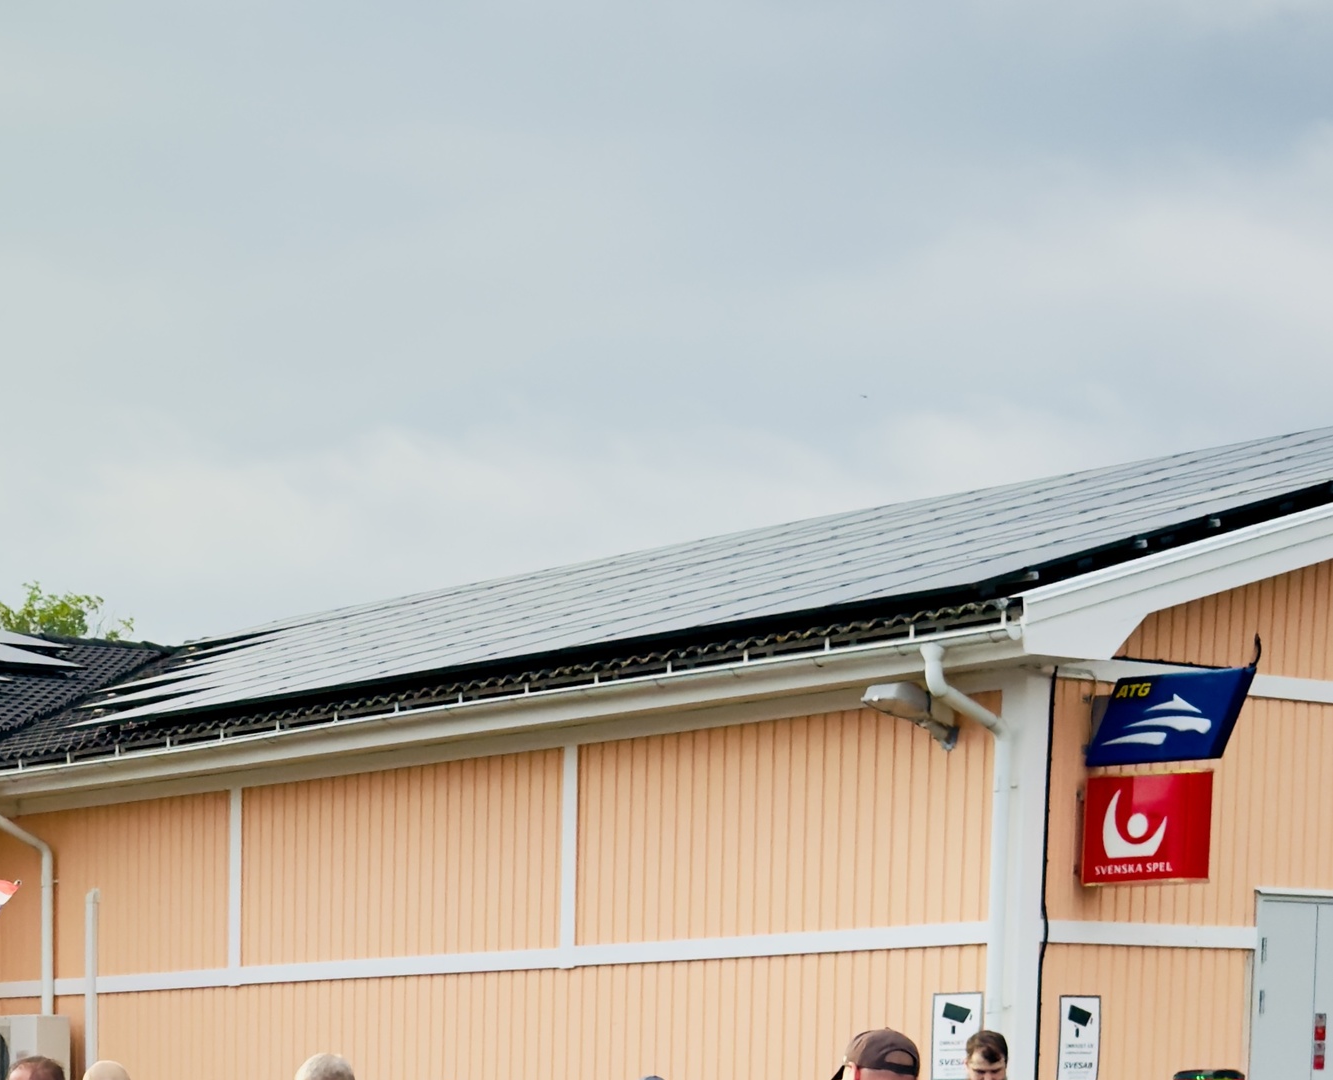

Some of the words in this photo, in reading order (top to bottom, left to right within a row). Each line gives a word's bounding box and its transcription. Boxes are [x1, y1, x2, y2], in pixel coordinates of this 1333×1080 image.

[1115, 682, 1152, 699] ATG
[1094, 863, 1143, 876] SVENSKA
[1145, 861, 1173, 873] SPEL
[1063, 1062, 1093, 1070] SVESAB
